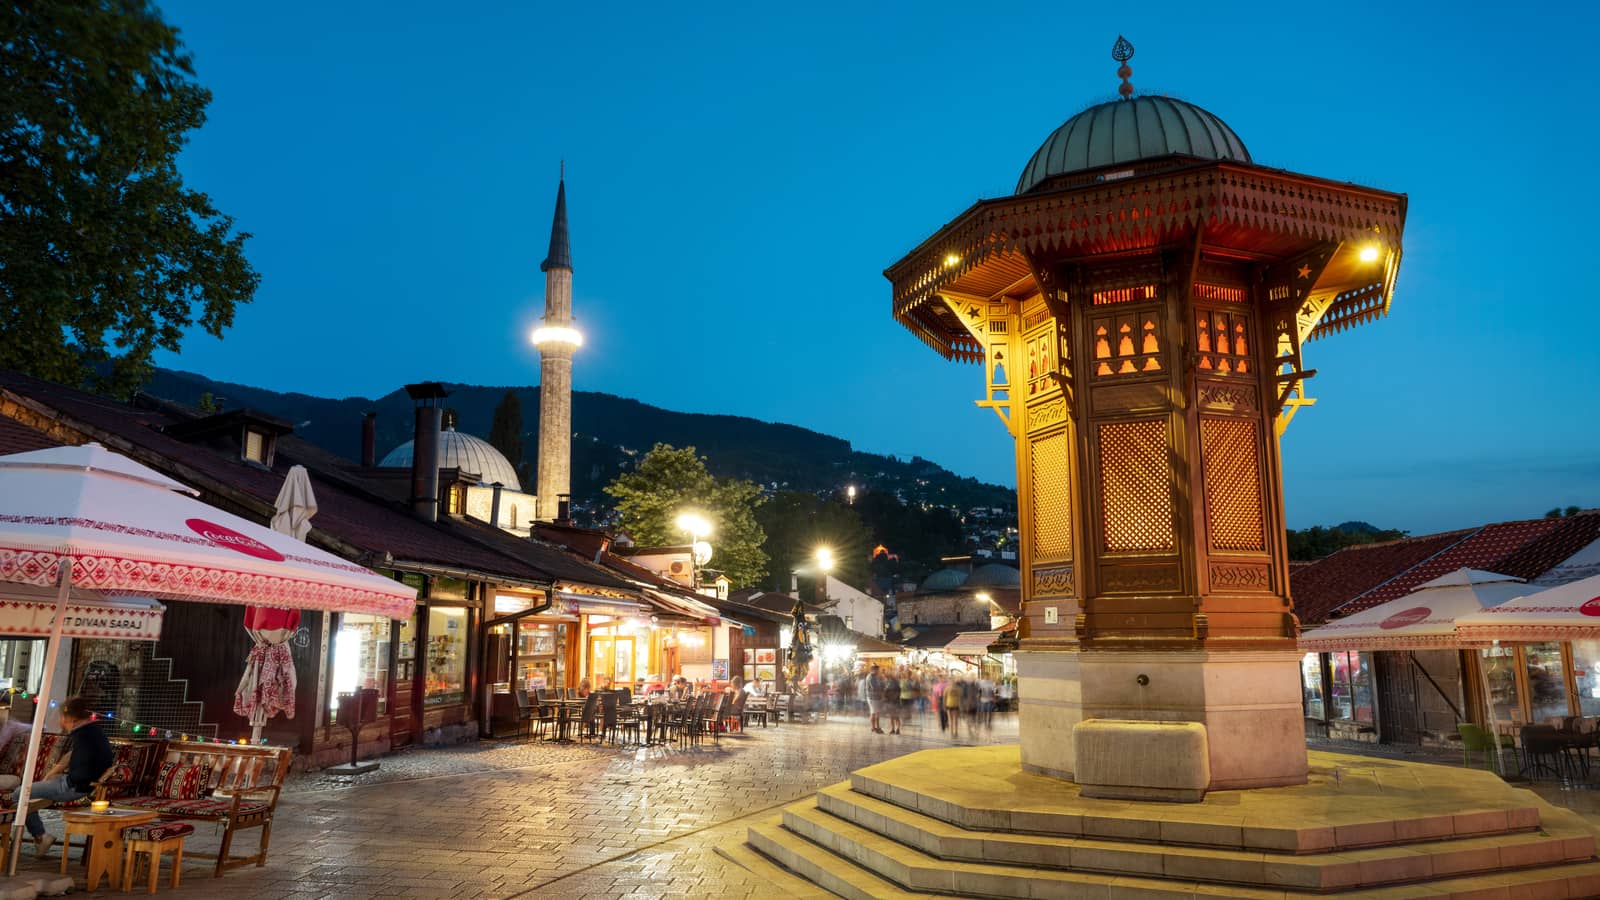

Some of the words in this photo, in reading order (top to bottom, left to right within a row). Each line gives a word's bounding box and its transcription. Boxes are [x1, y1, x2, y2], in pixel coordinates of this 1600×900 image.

[49, 616, 73, 626] AT
[75, 617, 107, 628] DIVAN
[109, 619, 142, 630] SARAJ
